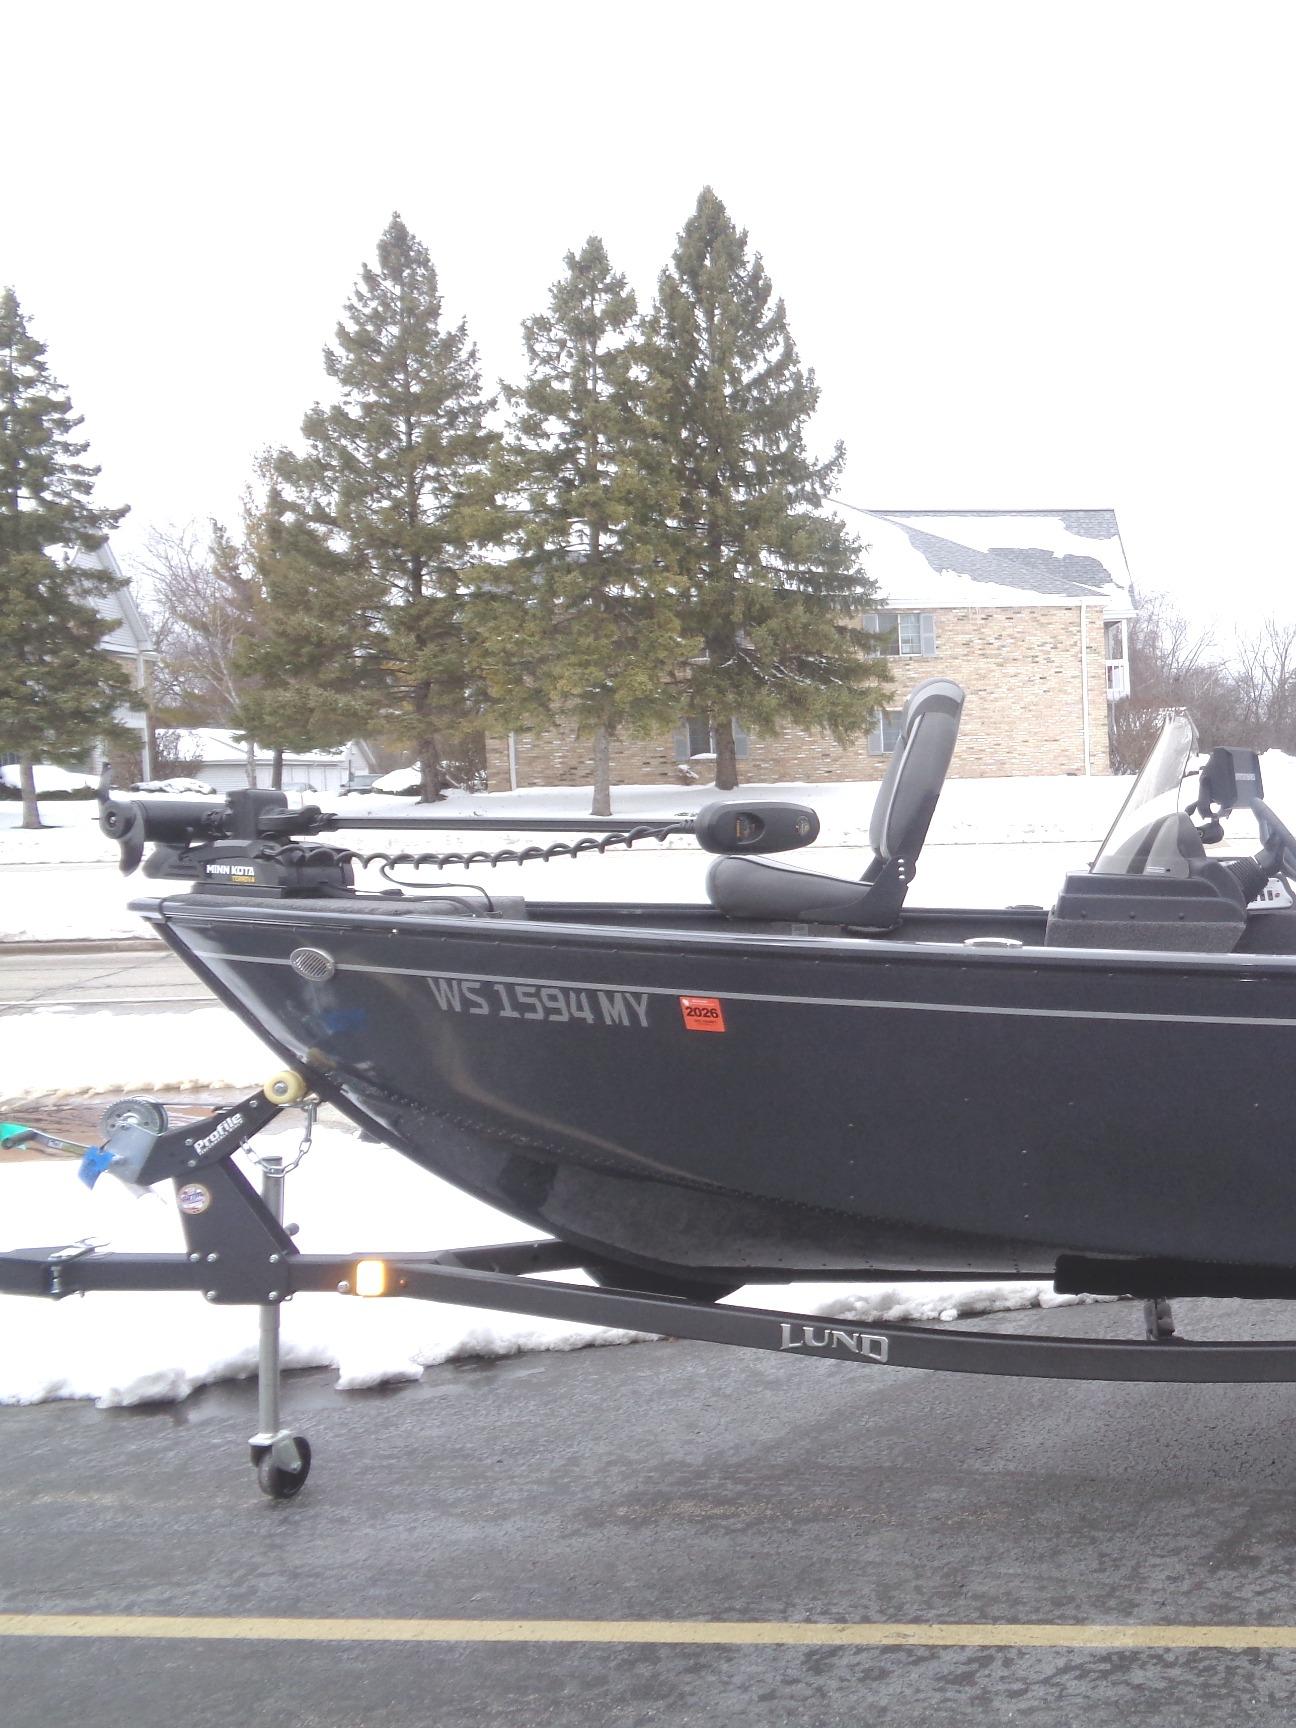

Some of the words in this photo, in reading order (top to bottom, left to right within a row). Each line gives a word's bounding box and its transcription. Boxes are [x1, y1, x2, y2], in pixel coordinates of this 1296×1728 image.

[206, 864, 230, 874] MINN
[231, 865, 255, 876] KOTA
[427, 977, 488, 1015] WS
[493, 983, 595, 1025] 1594
[597, 991, 649, 1028] MY
[685, 1006, 719, 1019] 2026
[193, 1113, 243, 1155] Profile
[780, 1323, 889, 1363] LUND
